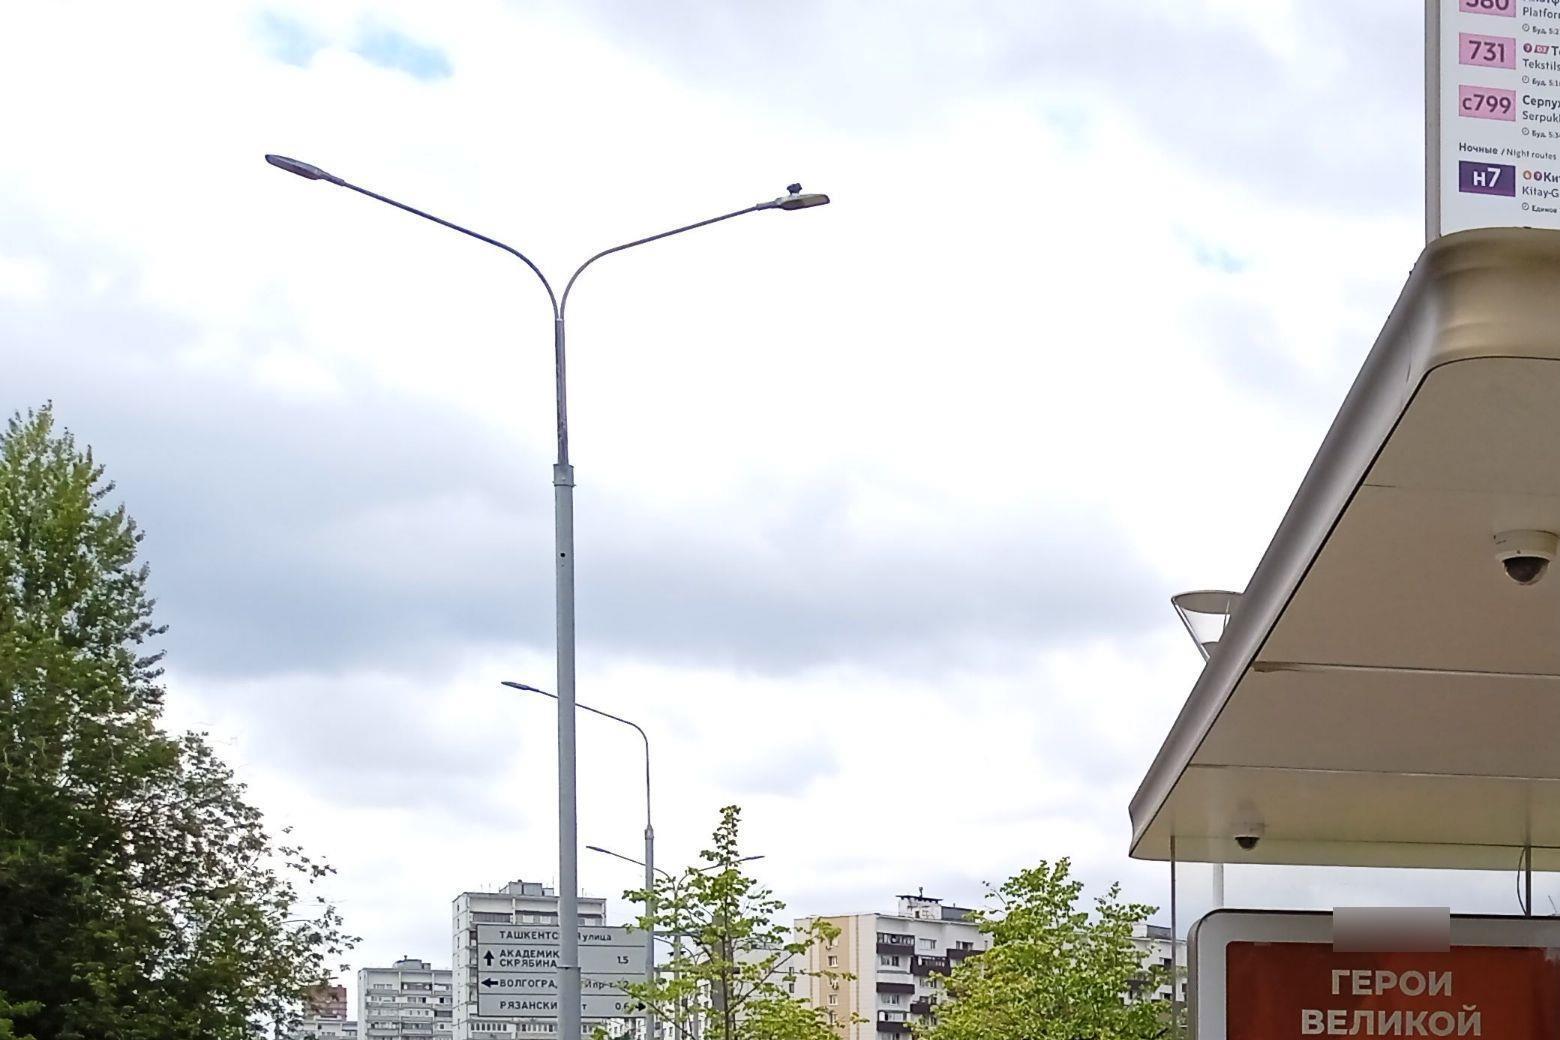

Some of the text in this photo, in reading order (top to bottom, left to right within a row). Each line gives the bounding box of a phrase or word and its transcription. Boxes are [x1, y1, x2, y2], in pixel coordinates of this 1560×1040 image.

[1469, 40, 1504, 62] 731
[1459, 142, 1498, 154] Ночные
[1507, 148, 1530, 158] Night
[1532, 151, 1557, 160] routes
[582, 934, 612, 942] улица
[500, 949, 560, 958] АКАДЕМИК
[500, 959, 557, 967] СКРЯБИНА
[1331, 969, 1453, 996] ГЕРОИ
[500, 1001, 558, 1010] РЯЗАНСКИ
[1301, 1004, 1482, 1037] ВЕЛИКОЙ
